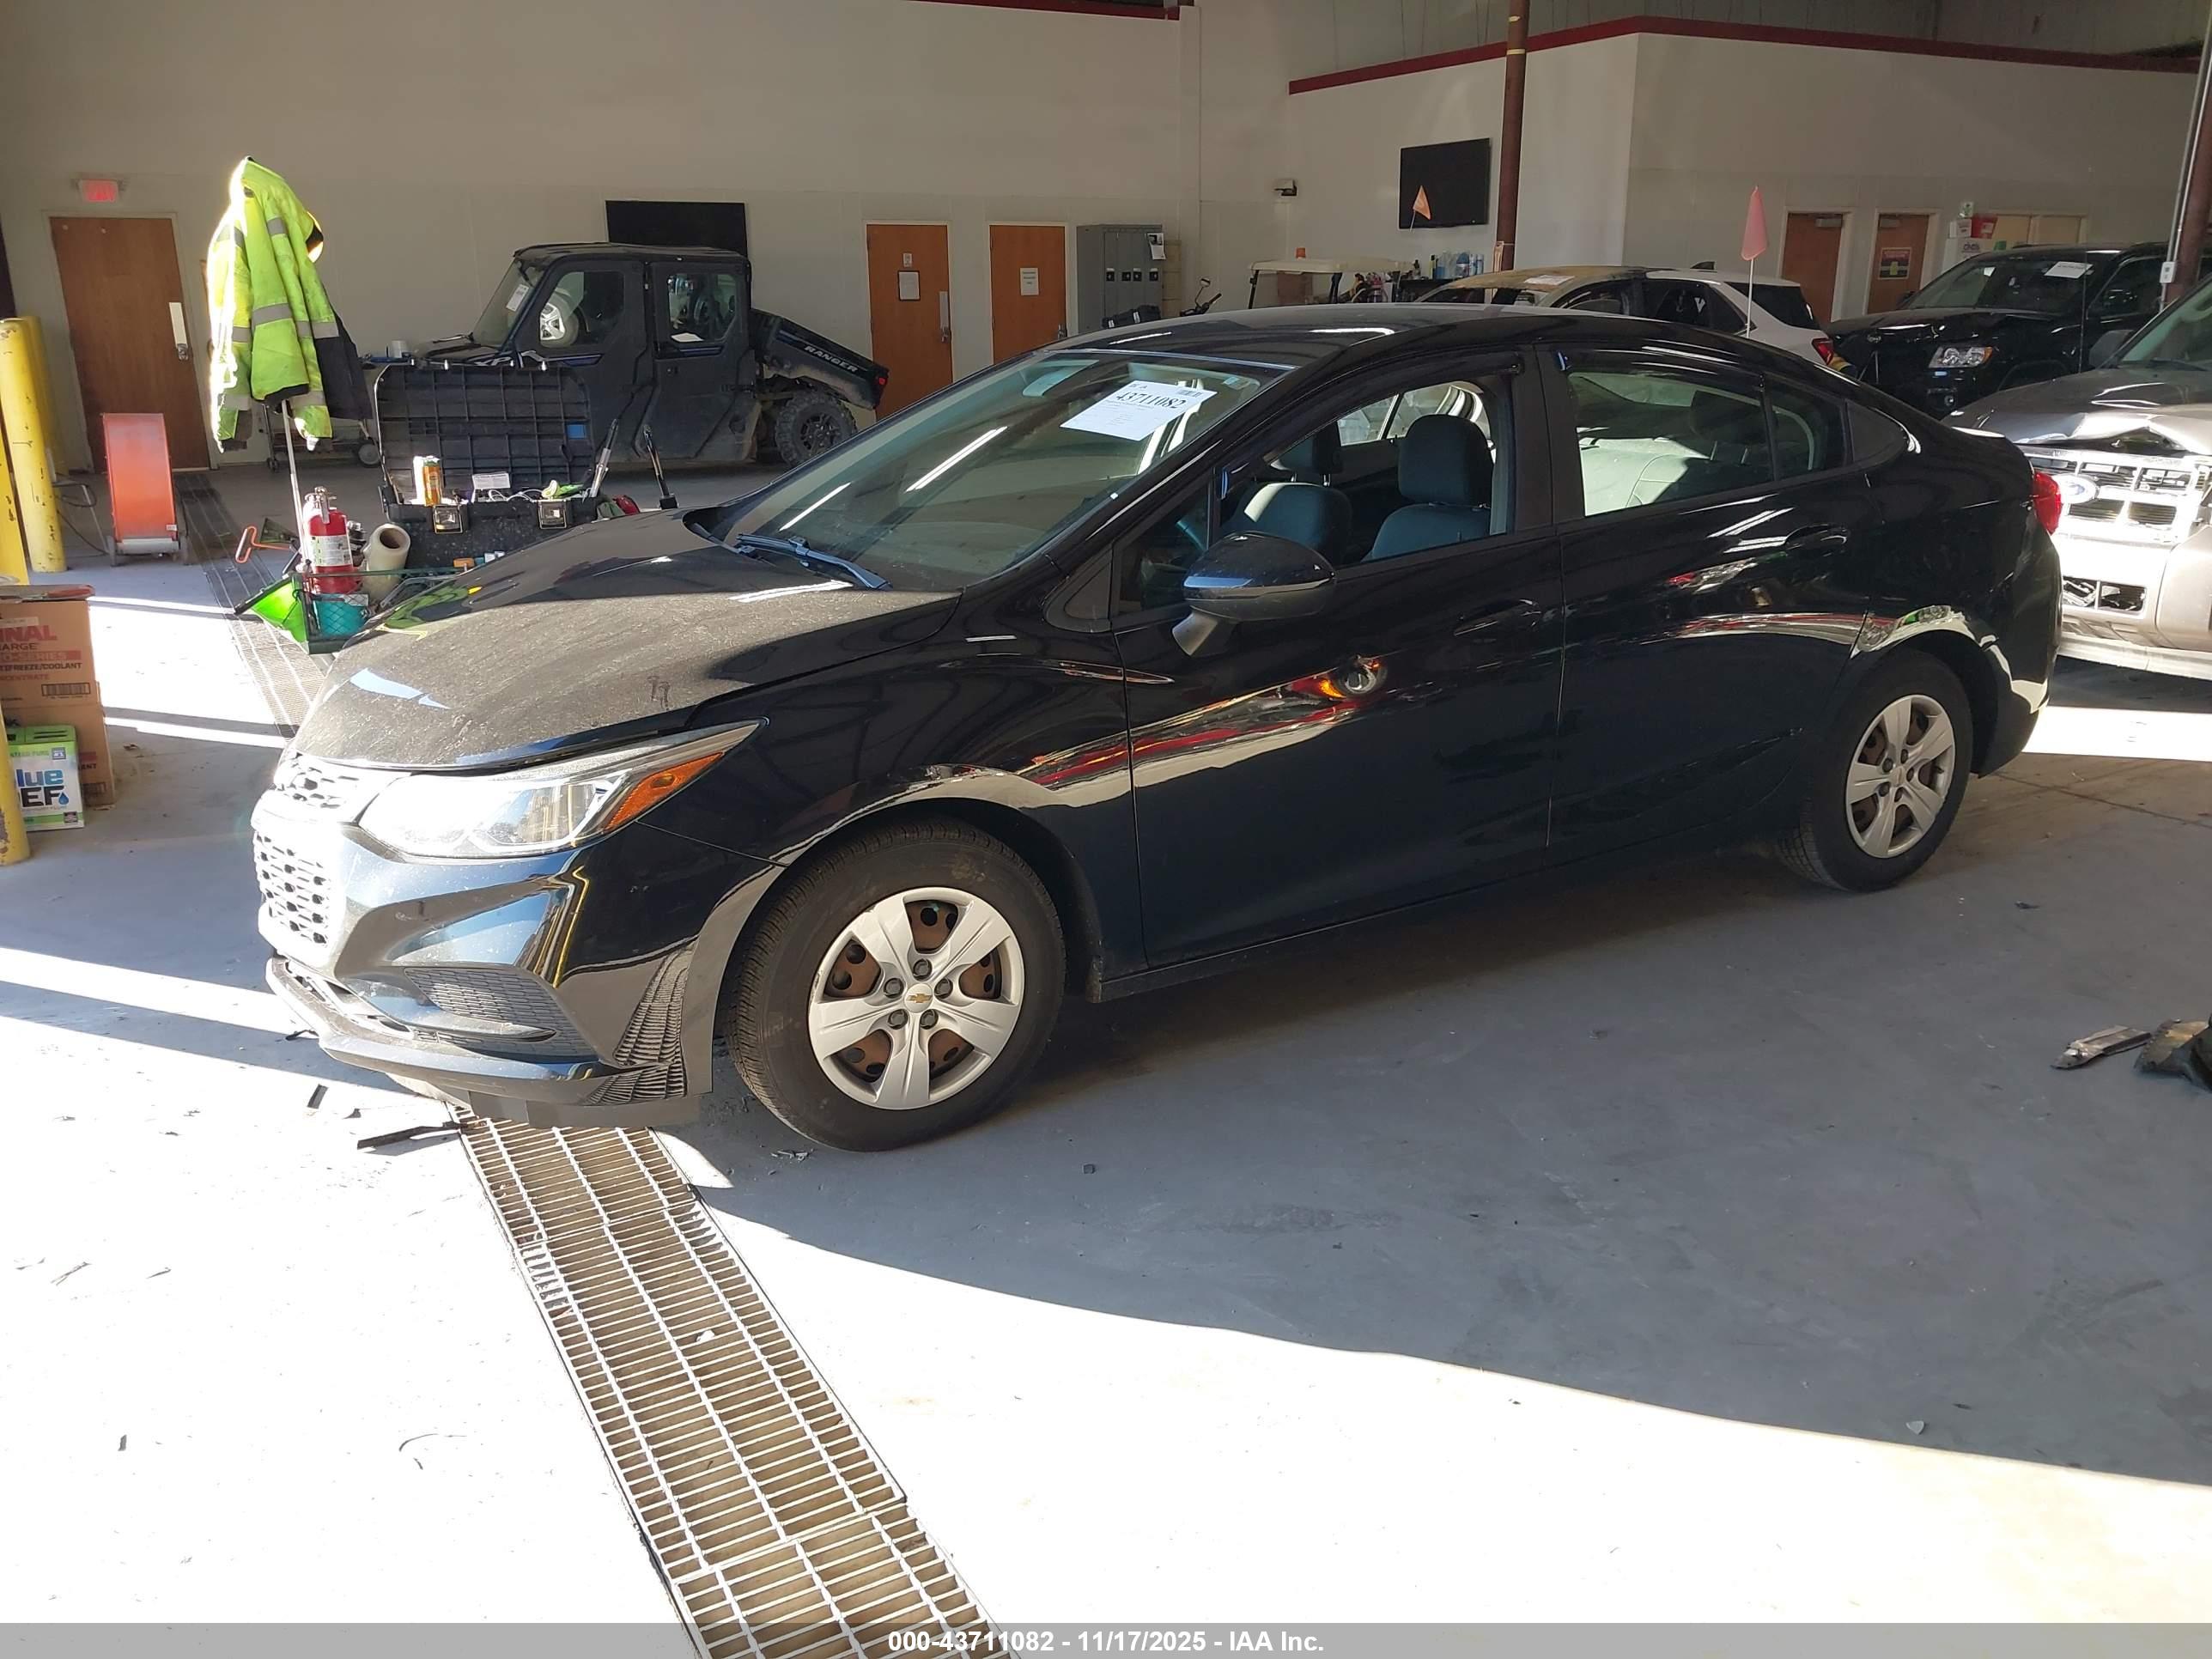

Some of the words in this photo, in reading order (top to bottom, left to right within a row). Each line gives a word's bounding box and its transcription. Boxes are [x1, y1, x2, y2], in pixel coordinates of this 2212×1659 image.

[805, 345, 858, 372] RANGER
[1116, 392, 1187, 409] 43711082
[15, 769, 64, 787] lue
[20, 785, 65, 808] EF
